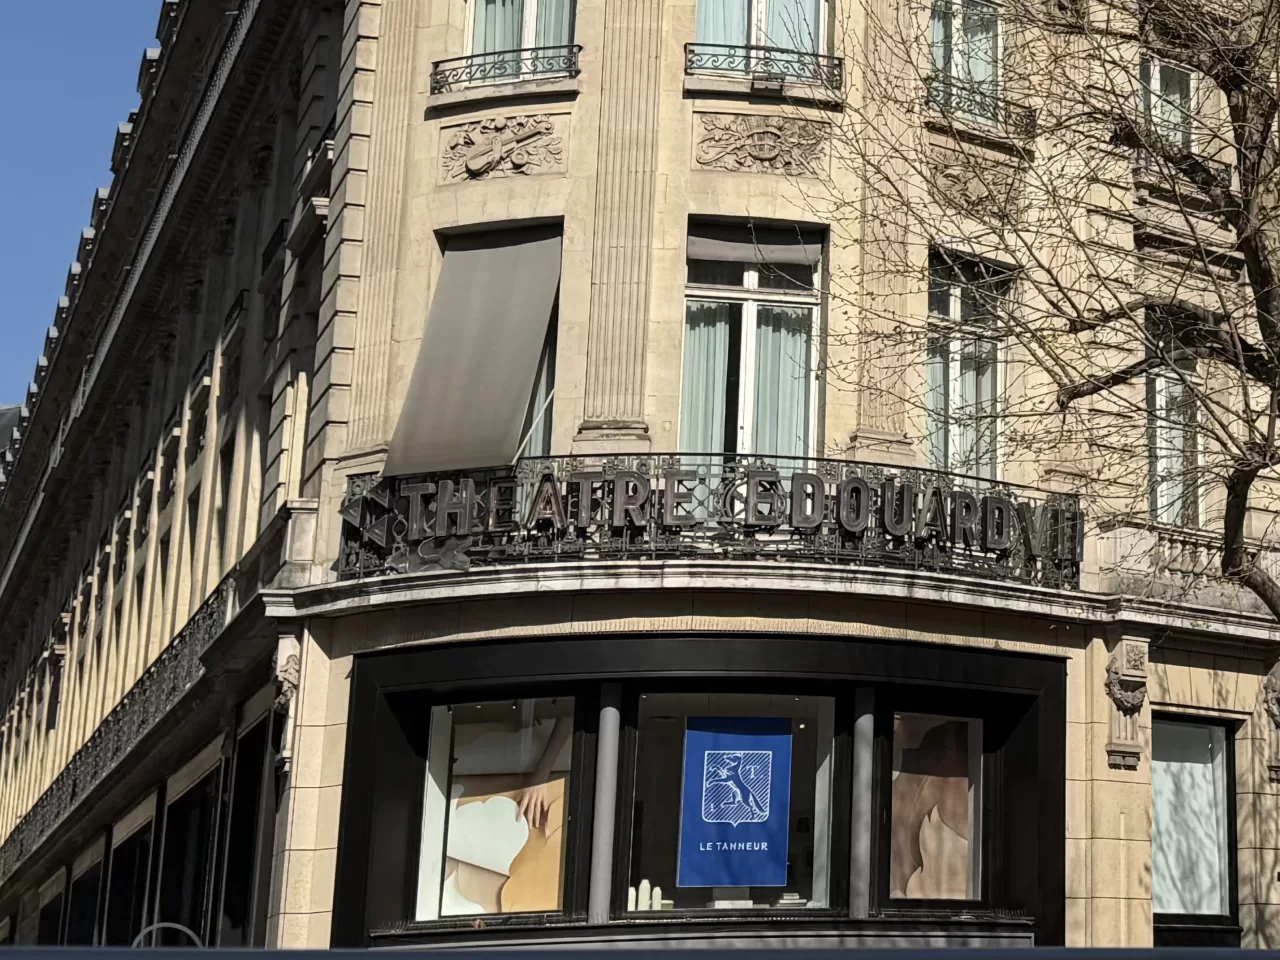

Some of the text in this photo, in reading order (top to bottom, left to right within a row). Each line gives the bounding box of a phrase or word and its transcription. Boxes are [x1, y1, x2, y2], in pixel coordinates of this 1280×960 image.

[400, 470, 1085, 564] THEATRE EDOUARD VII
[699, 842, 769, 851] LE TANNEUR
